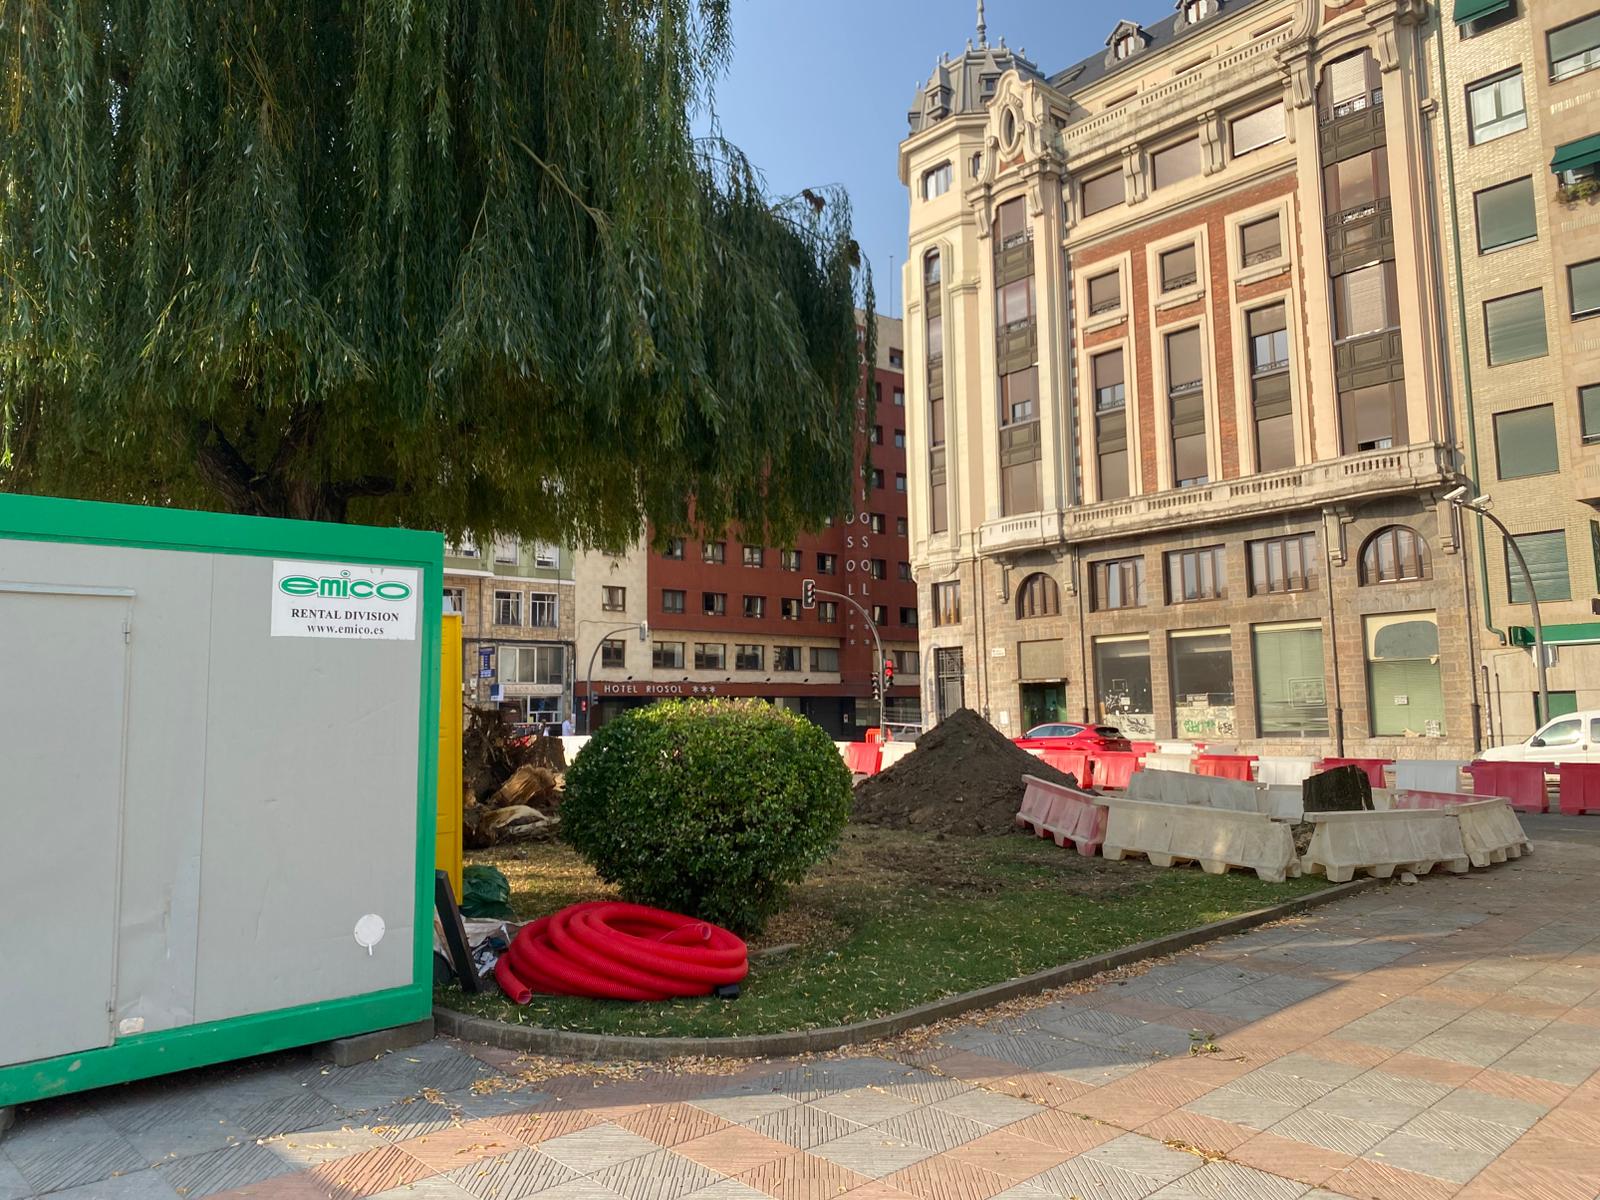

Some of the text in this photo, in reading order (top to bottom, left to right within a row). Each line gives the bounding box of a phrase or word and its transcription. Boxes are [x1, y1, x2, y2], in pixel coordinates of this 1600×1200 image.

[279, 569, 412, 601] emico
[291, 608, 400, 622] RENTAL DIVISION
[306, 623, 385, 636] www.emico.es
[604, 684, 683, 695] HOTEL RIOSOL
